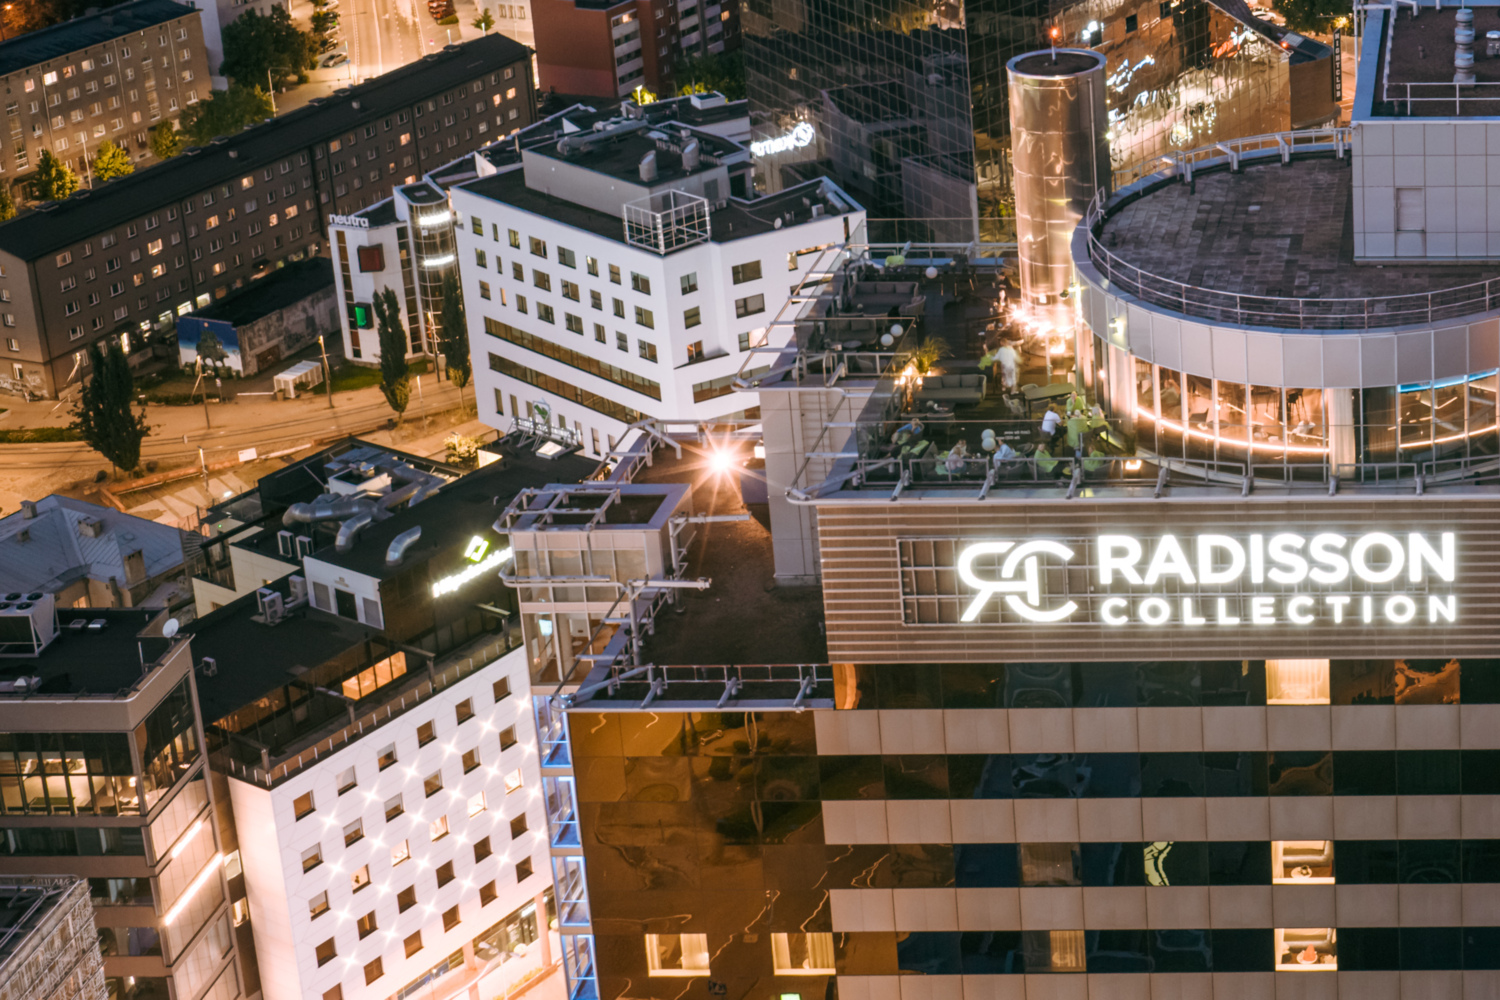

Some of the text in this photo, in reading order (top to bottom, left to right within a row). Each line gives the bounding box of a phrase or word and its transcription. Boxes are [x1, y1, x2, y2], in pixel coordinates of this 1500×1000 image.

[329, 213, 369, 229] neutra
[1098, 531, 1456, 585] RADISSON
[1100, 595, 1457, 625] COLLECTION
